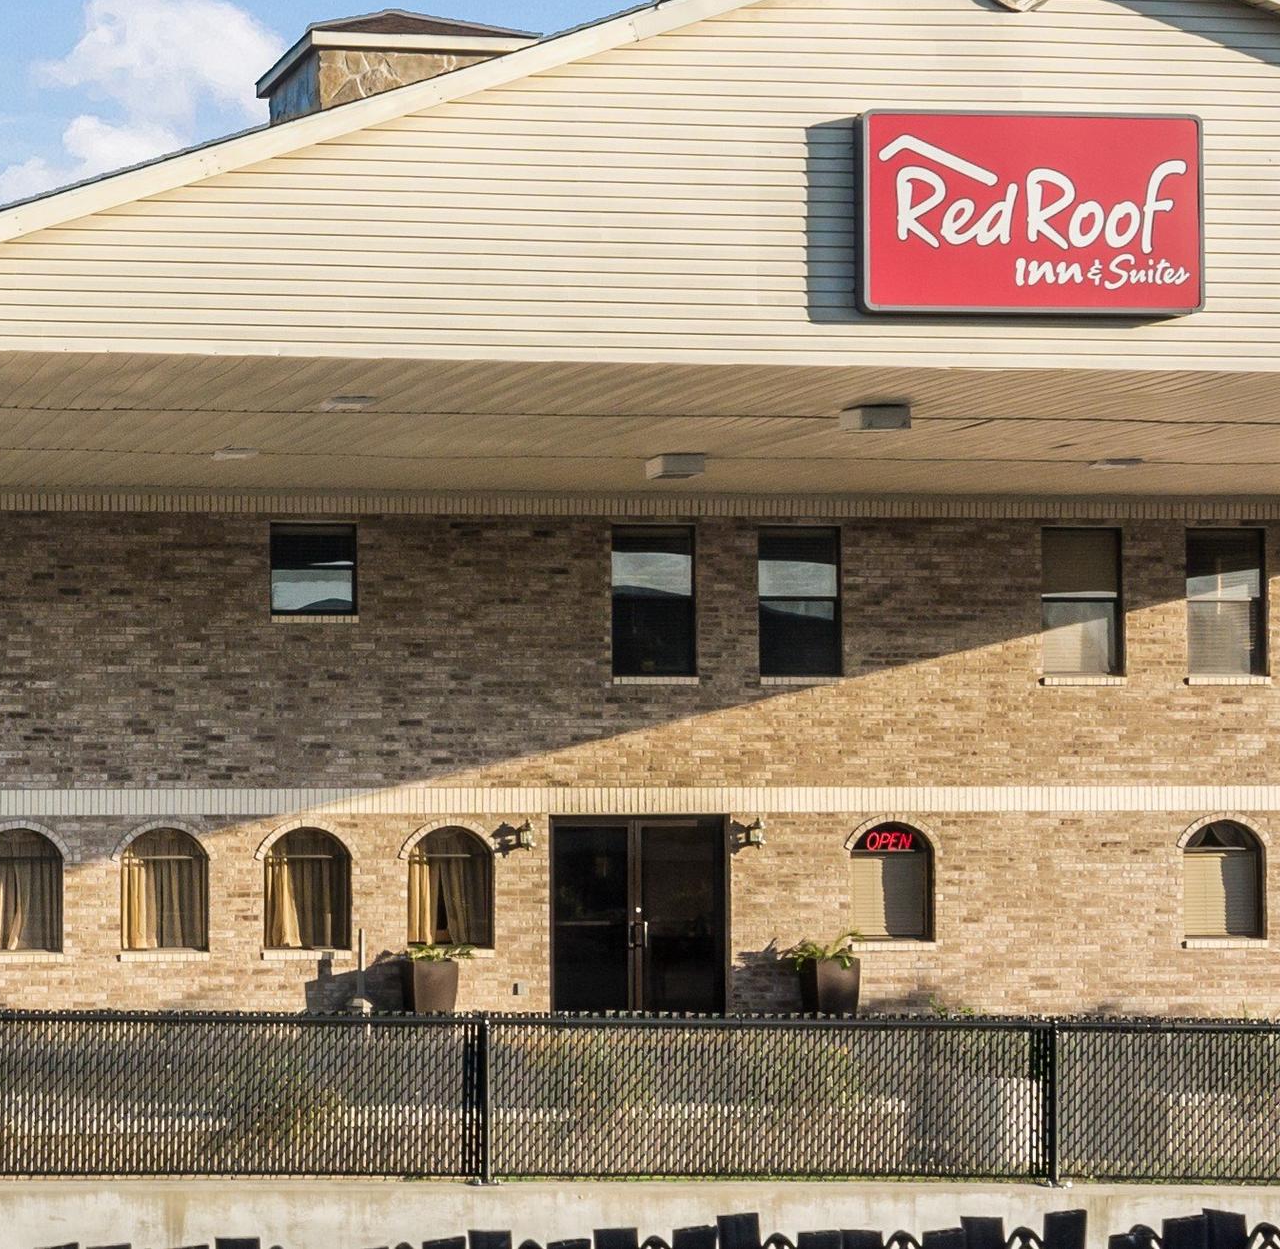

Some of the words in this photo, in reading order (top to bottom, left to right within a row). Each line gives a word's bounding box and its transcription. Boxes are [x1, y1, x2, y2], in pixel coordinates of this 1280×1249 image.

[895, 166, 1018, 248] Red
[1025, 160, 1187, 254] Roof
[1015, 257, 1083, 287] Inn
[1086, 259, 1102, 283] &
[1104, 253, 1190, 290] Suites
[866, 831, 912, 851] OPEN
